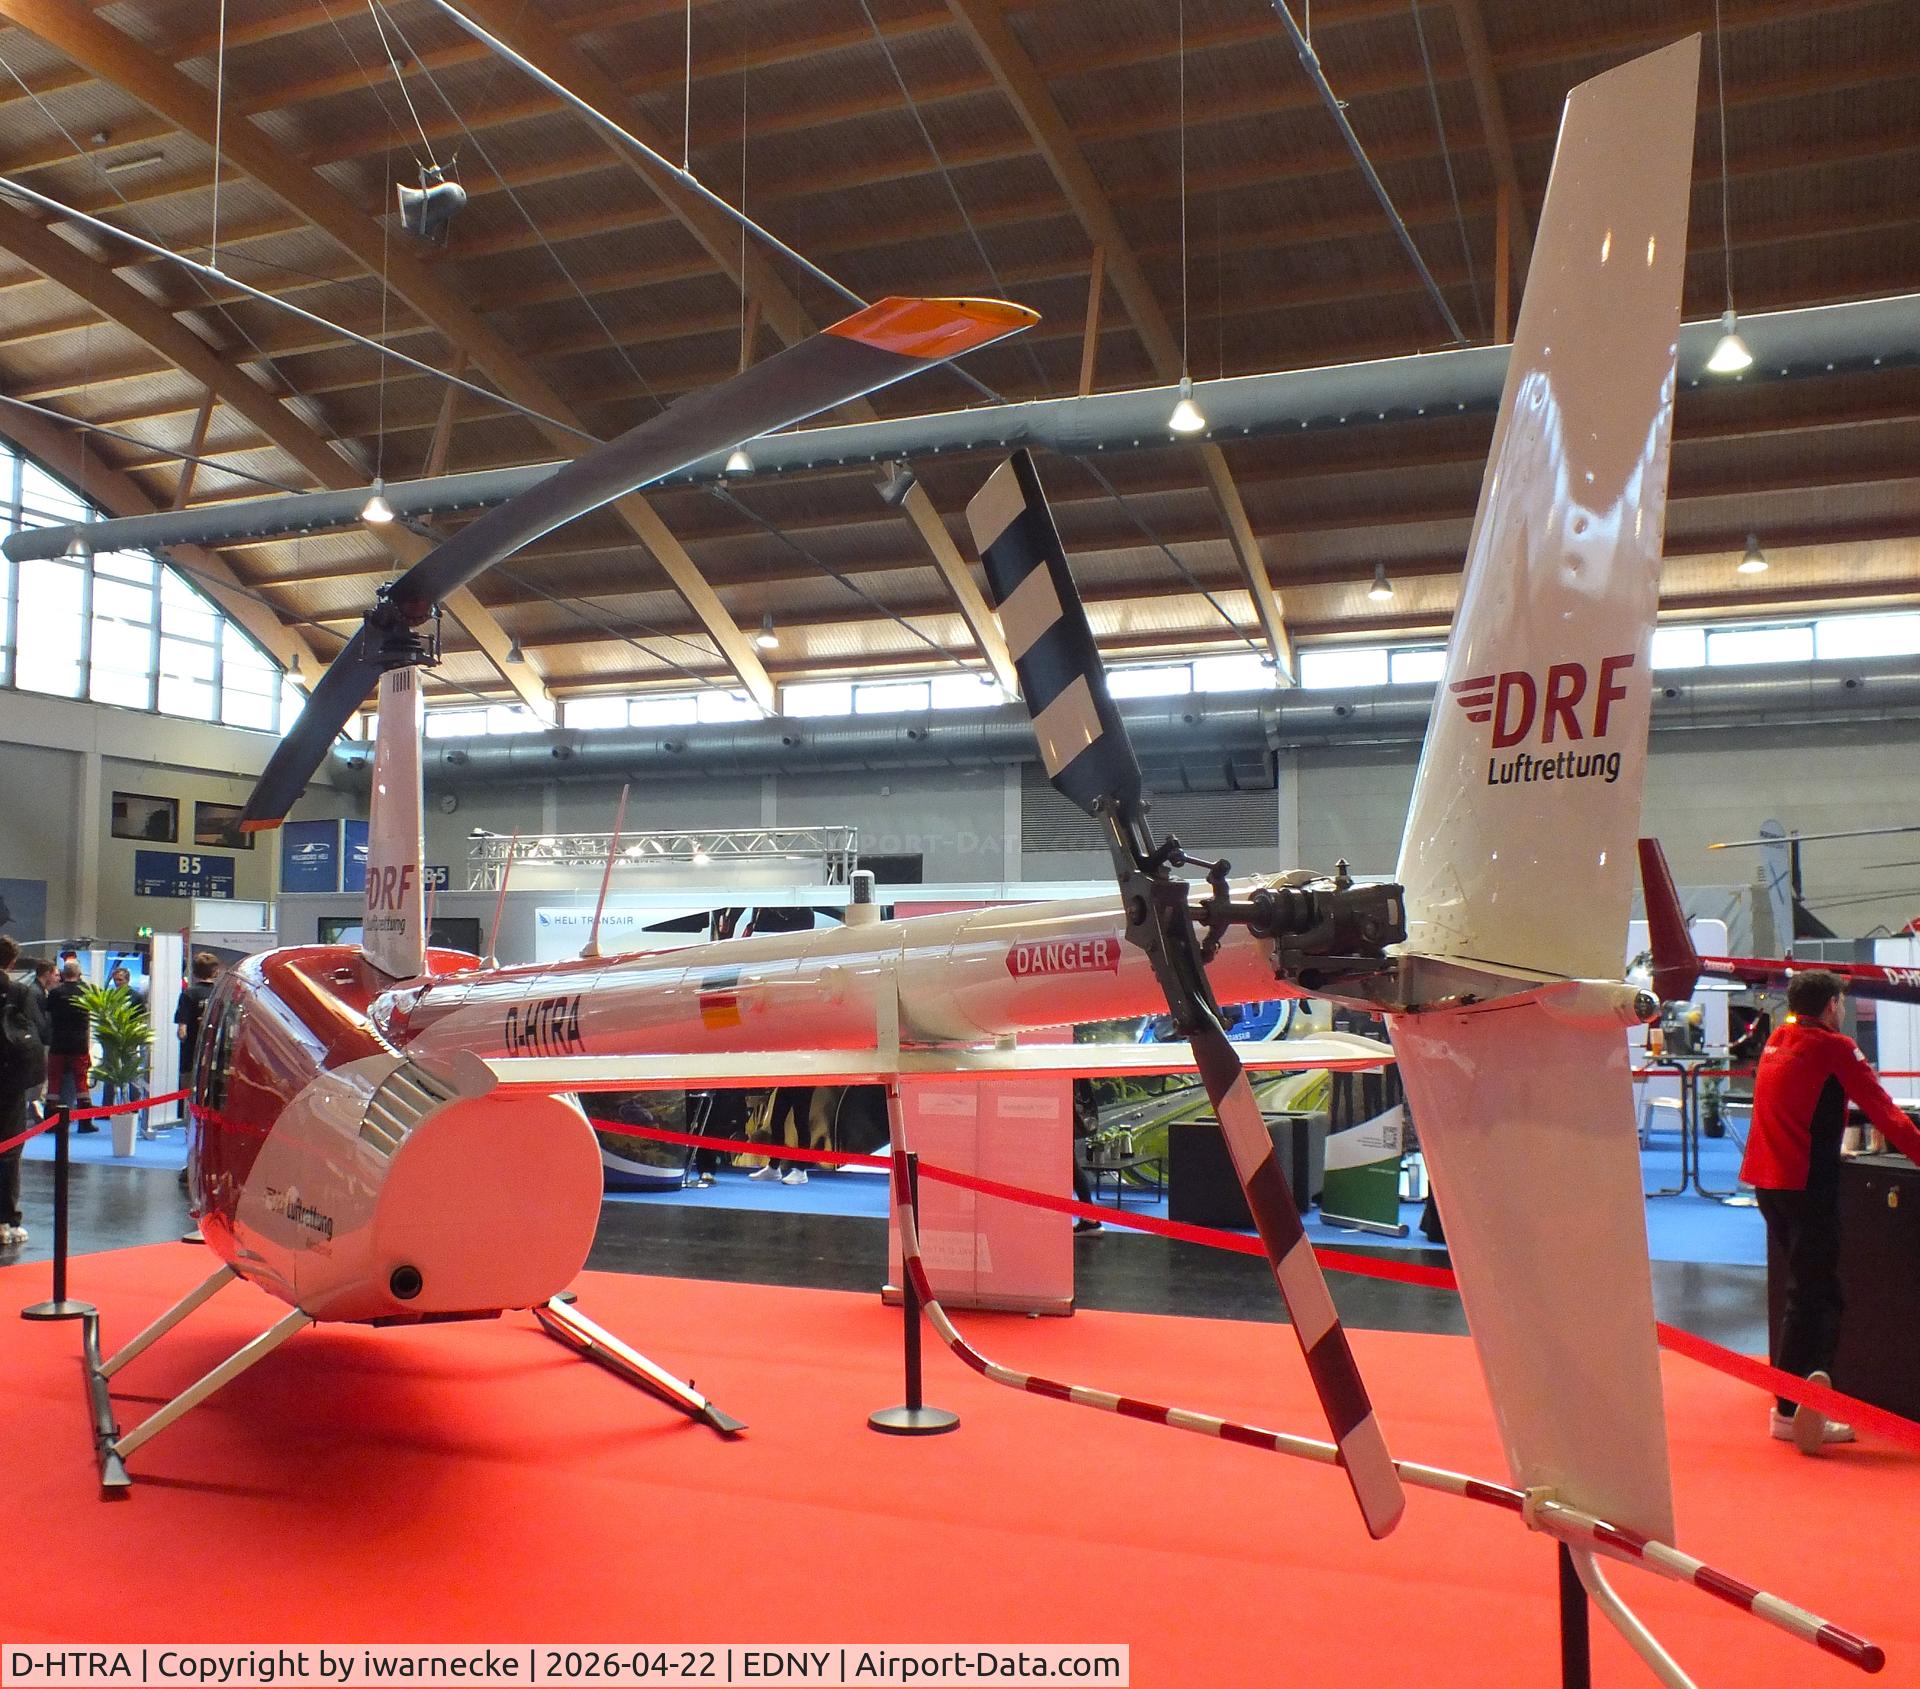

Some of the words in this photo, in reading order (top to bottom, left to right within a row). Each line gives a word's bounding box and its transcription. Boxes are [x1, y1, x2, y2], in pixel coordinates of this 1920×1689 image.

[1492, 654, 1635, 749] DRF
[1488, 750, 1621, 786] Luftrettung
[368, 864, 416, 911] DRF
[554, 916, 577, 925] HELI
[581, 916, 634, 925] TRNSAIR
[1016, 939, 1109, 974] DANGER
[505, 993, 586, 1057] D-HTRA
